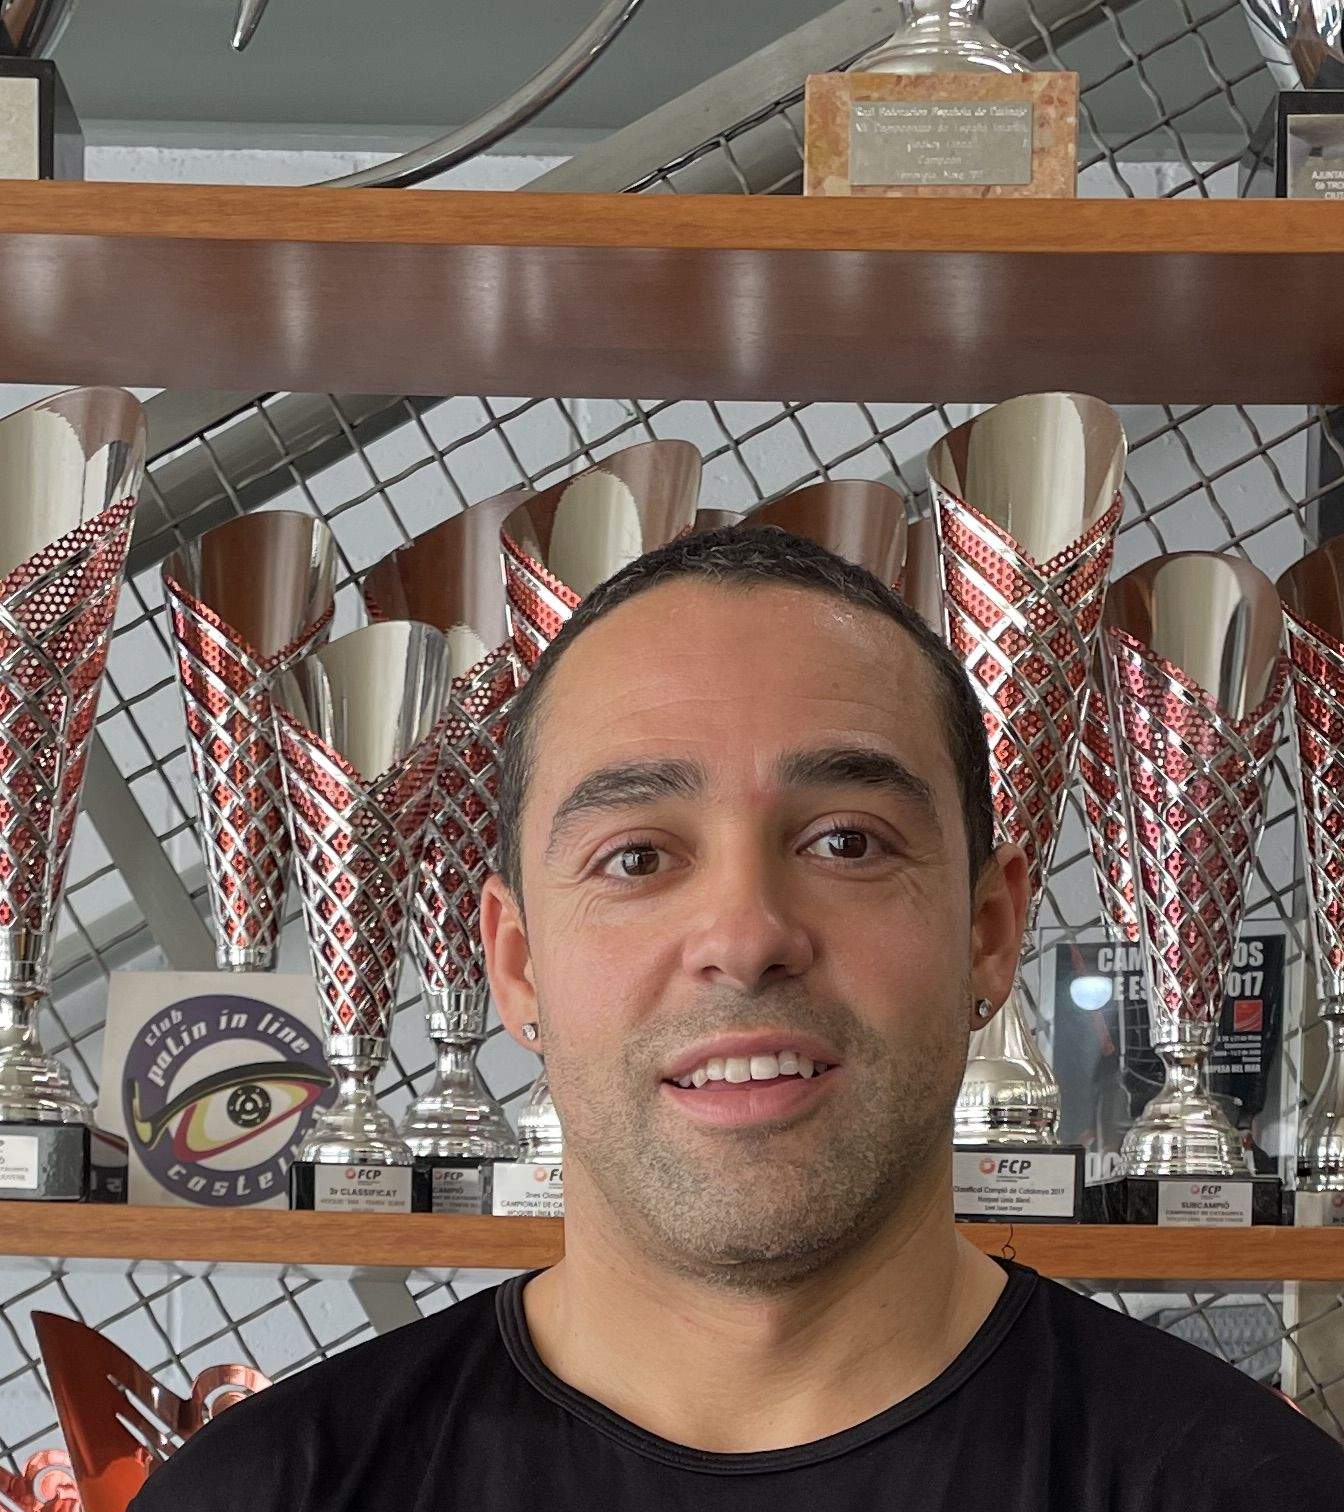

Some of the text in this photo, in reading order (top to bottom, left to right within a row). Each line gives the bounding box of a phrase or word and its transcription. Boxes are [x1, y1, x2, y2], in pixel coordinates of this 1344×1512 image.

[144, 1009, 183, 1047] club
[219, 1009, 248, 1030] in
[257, 1013, 310, 1054] line
[997, 1159, 1031, 1174] FCP
[357, 1169, 381, 1180] FCP
[443, 1172, 464, 1181] FCP
[340, 1187, 398, 1197] CLASSIFICAT
[1201, 1186, 1221, 1194] FCP
